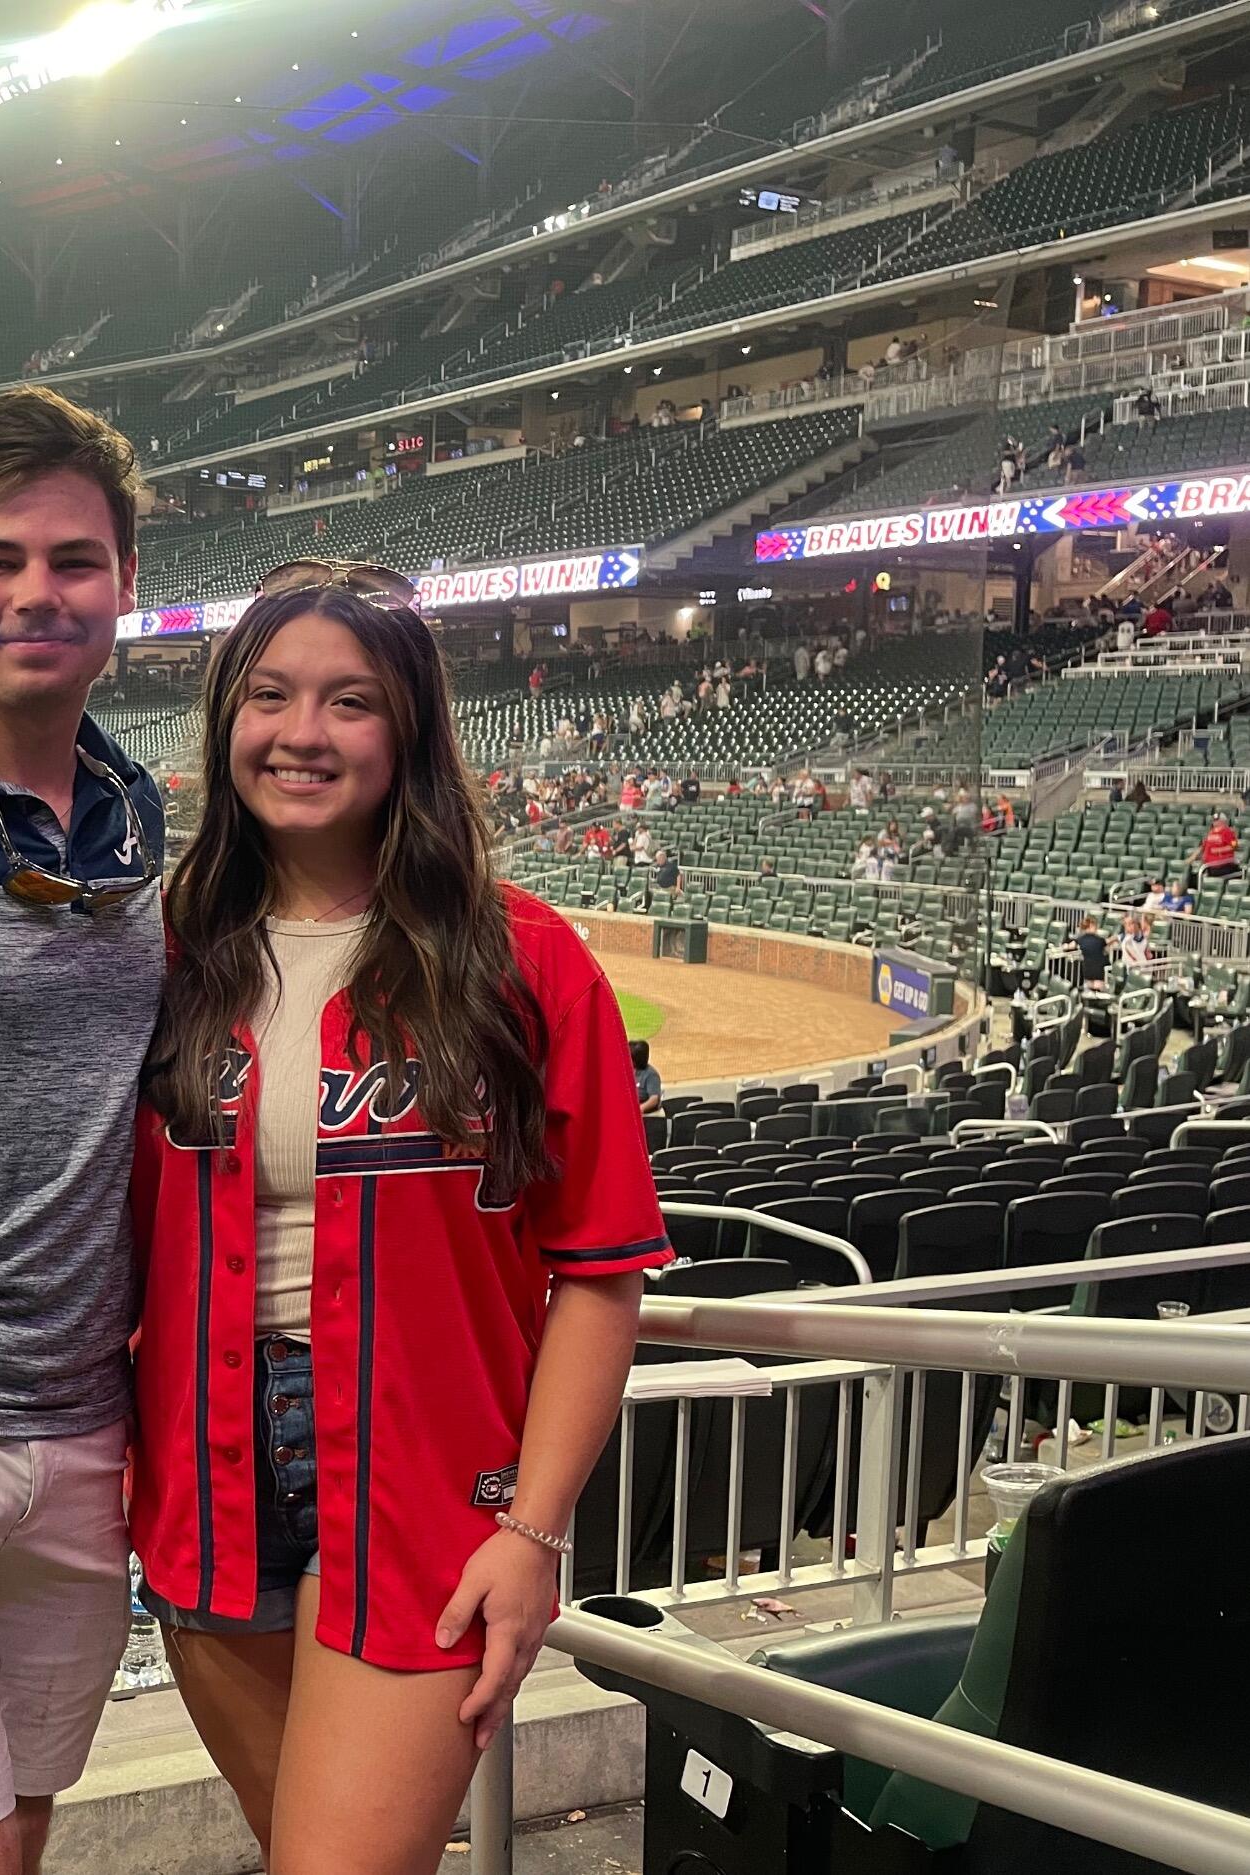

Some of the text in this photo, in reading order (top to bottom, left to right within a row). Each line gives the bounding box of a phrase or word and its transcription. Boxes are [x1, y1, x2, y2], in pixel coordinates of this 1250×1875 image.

[1175, 475, 1250, 519] BRA
[803, 502, 1021, 557] BRAVES WIN!!
[418, 556, 602, 607] BRAVES WIN!!
[702, 1769, 712, 1798] 1
